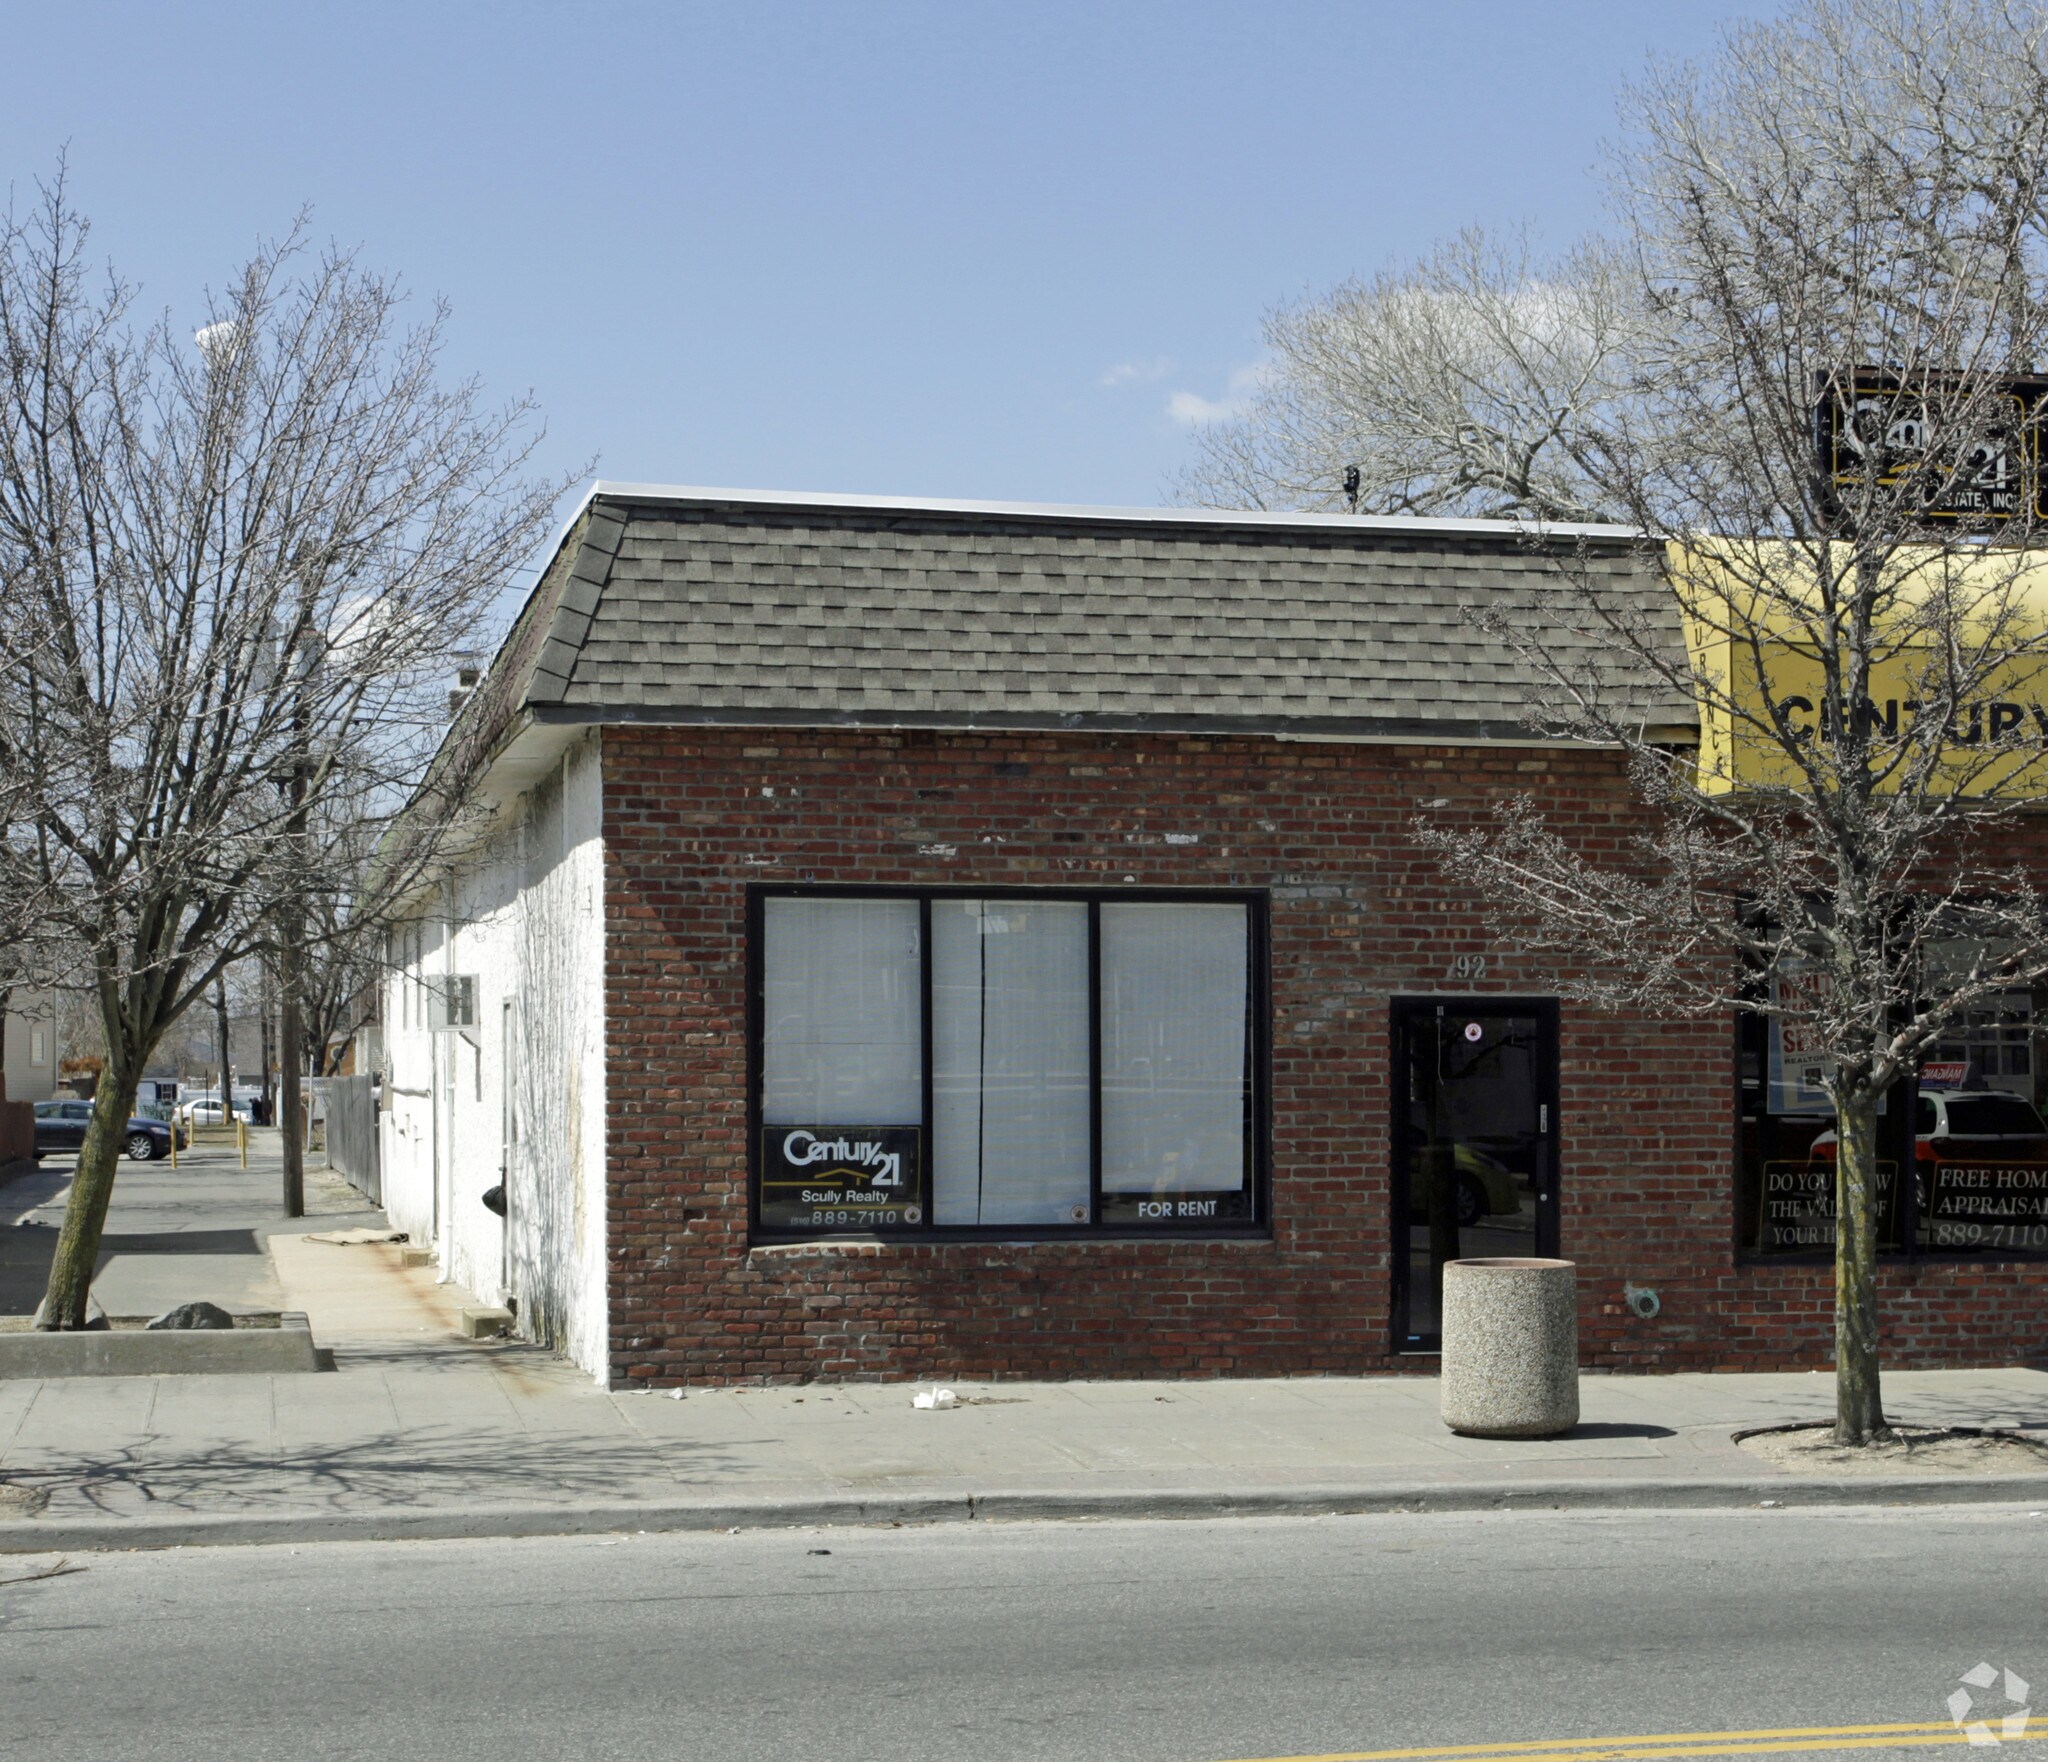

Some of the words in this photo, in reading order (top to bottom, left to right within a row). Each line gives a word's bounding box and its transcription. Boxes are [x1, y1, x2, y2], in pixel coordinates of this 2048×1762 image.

[1938, 491, 1986, 508] STATE,
[1457, 955, 1486, 978] 92
[783, 1129, 882, 1166] Century
[872, 1153, 900, 1186] 21
[1769, 1174, 1793, 1191] DO
[1798, 1173, 1833, 1191] YOU
[1939, 1168, 1991, 1188] FREE
[802, 1190, 841, 1205] Scully
[846, 1190, 889, 1205] Realty
[1138, 1202, 1172, 1217] FOR
[1178, 1200, 1217, 1216] RENT
[1769, 1200, 1801, 1217] THE
[1806, 1200, 1837, 1217] VAL
[812, 1210, 897, 1226] 889-7110
[1774, 1227, 1818, 1244] YOUR
[1936, 1224, 2047, 1247] 889-7110
